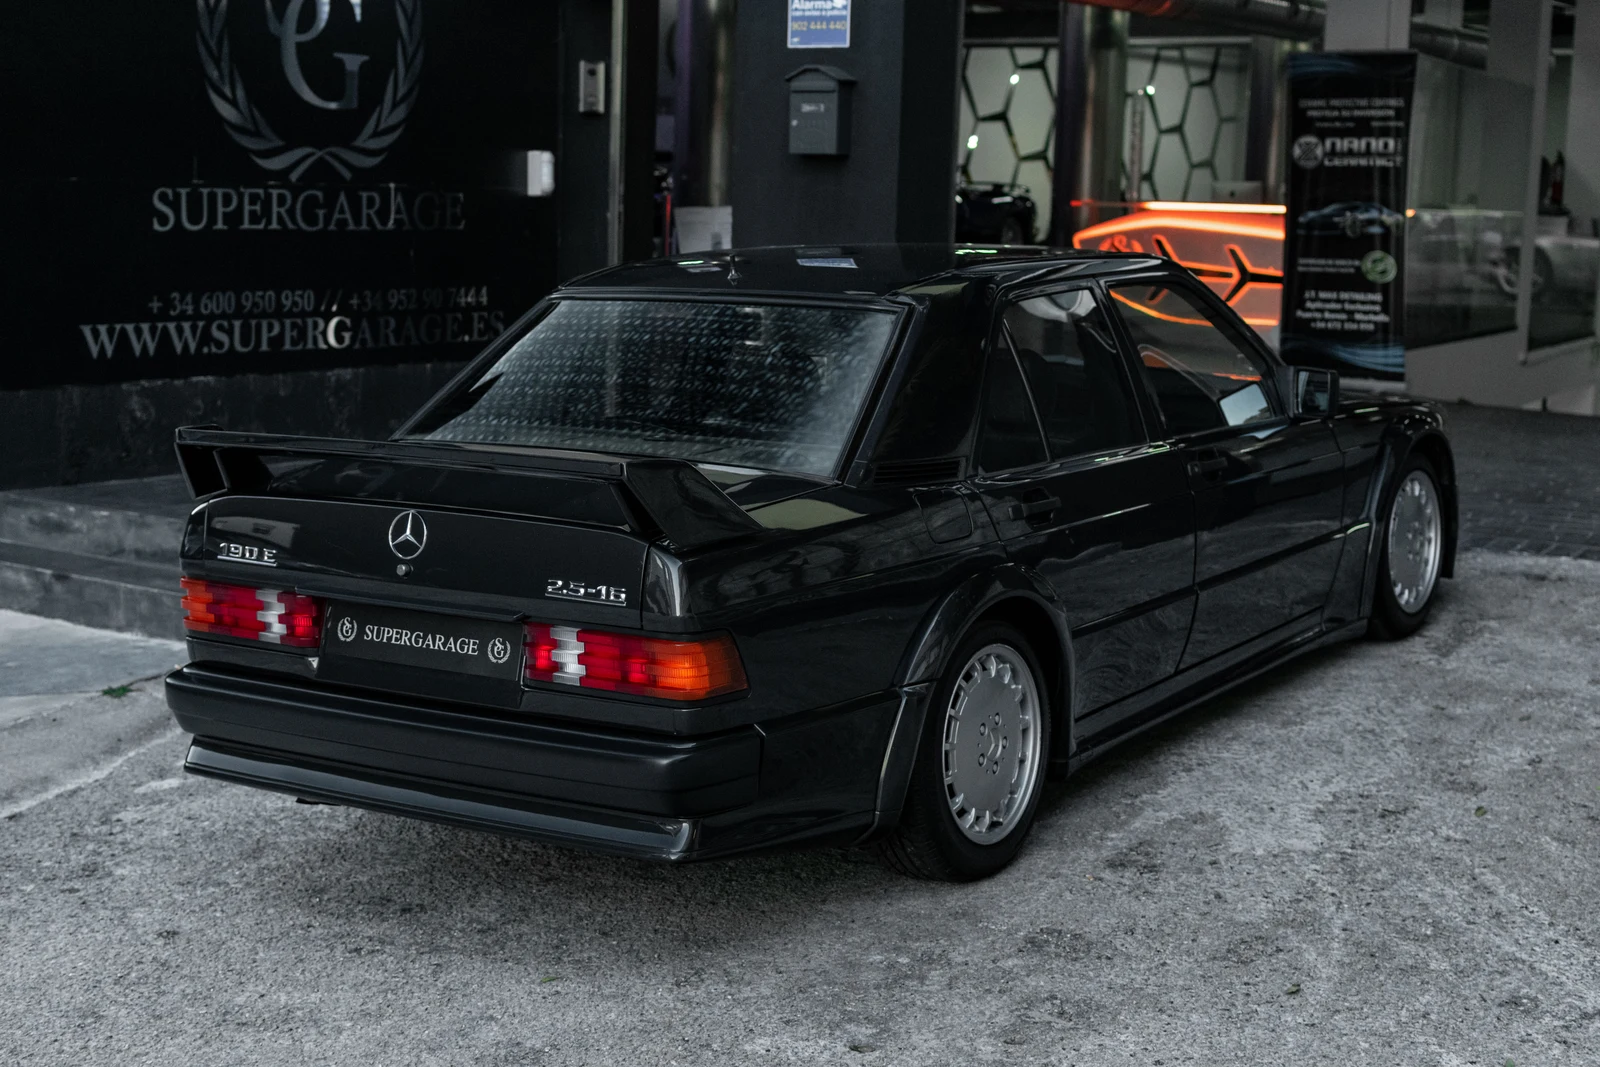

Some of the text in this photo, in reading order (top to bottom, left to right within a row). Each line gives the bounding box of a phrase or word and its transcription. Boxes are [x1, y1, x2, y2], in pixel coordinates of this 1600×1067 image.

[151, 186, 467, 232] SUPERGARAGE
[169, 292, 195, 316] 34
[200, 291, 235, 315] 600
[241, 290, 275, 314] 950
[281, 289, 314, 313] 950
[388, 287, 418, 310] 952
[447, 285, 489, 309] 7444
[80, 310, 506, 361] WWW.SUPERGARAGE.ES
[219, 542, 277, 562] 190 E
[546, 579, 627, 602] 2.5-16
[363, 624, 480, 656] SUPERGARAGE
